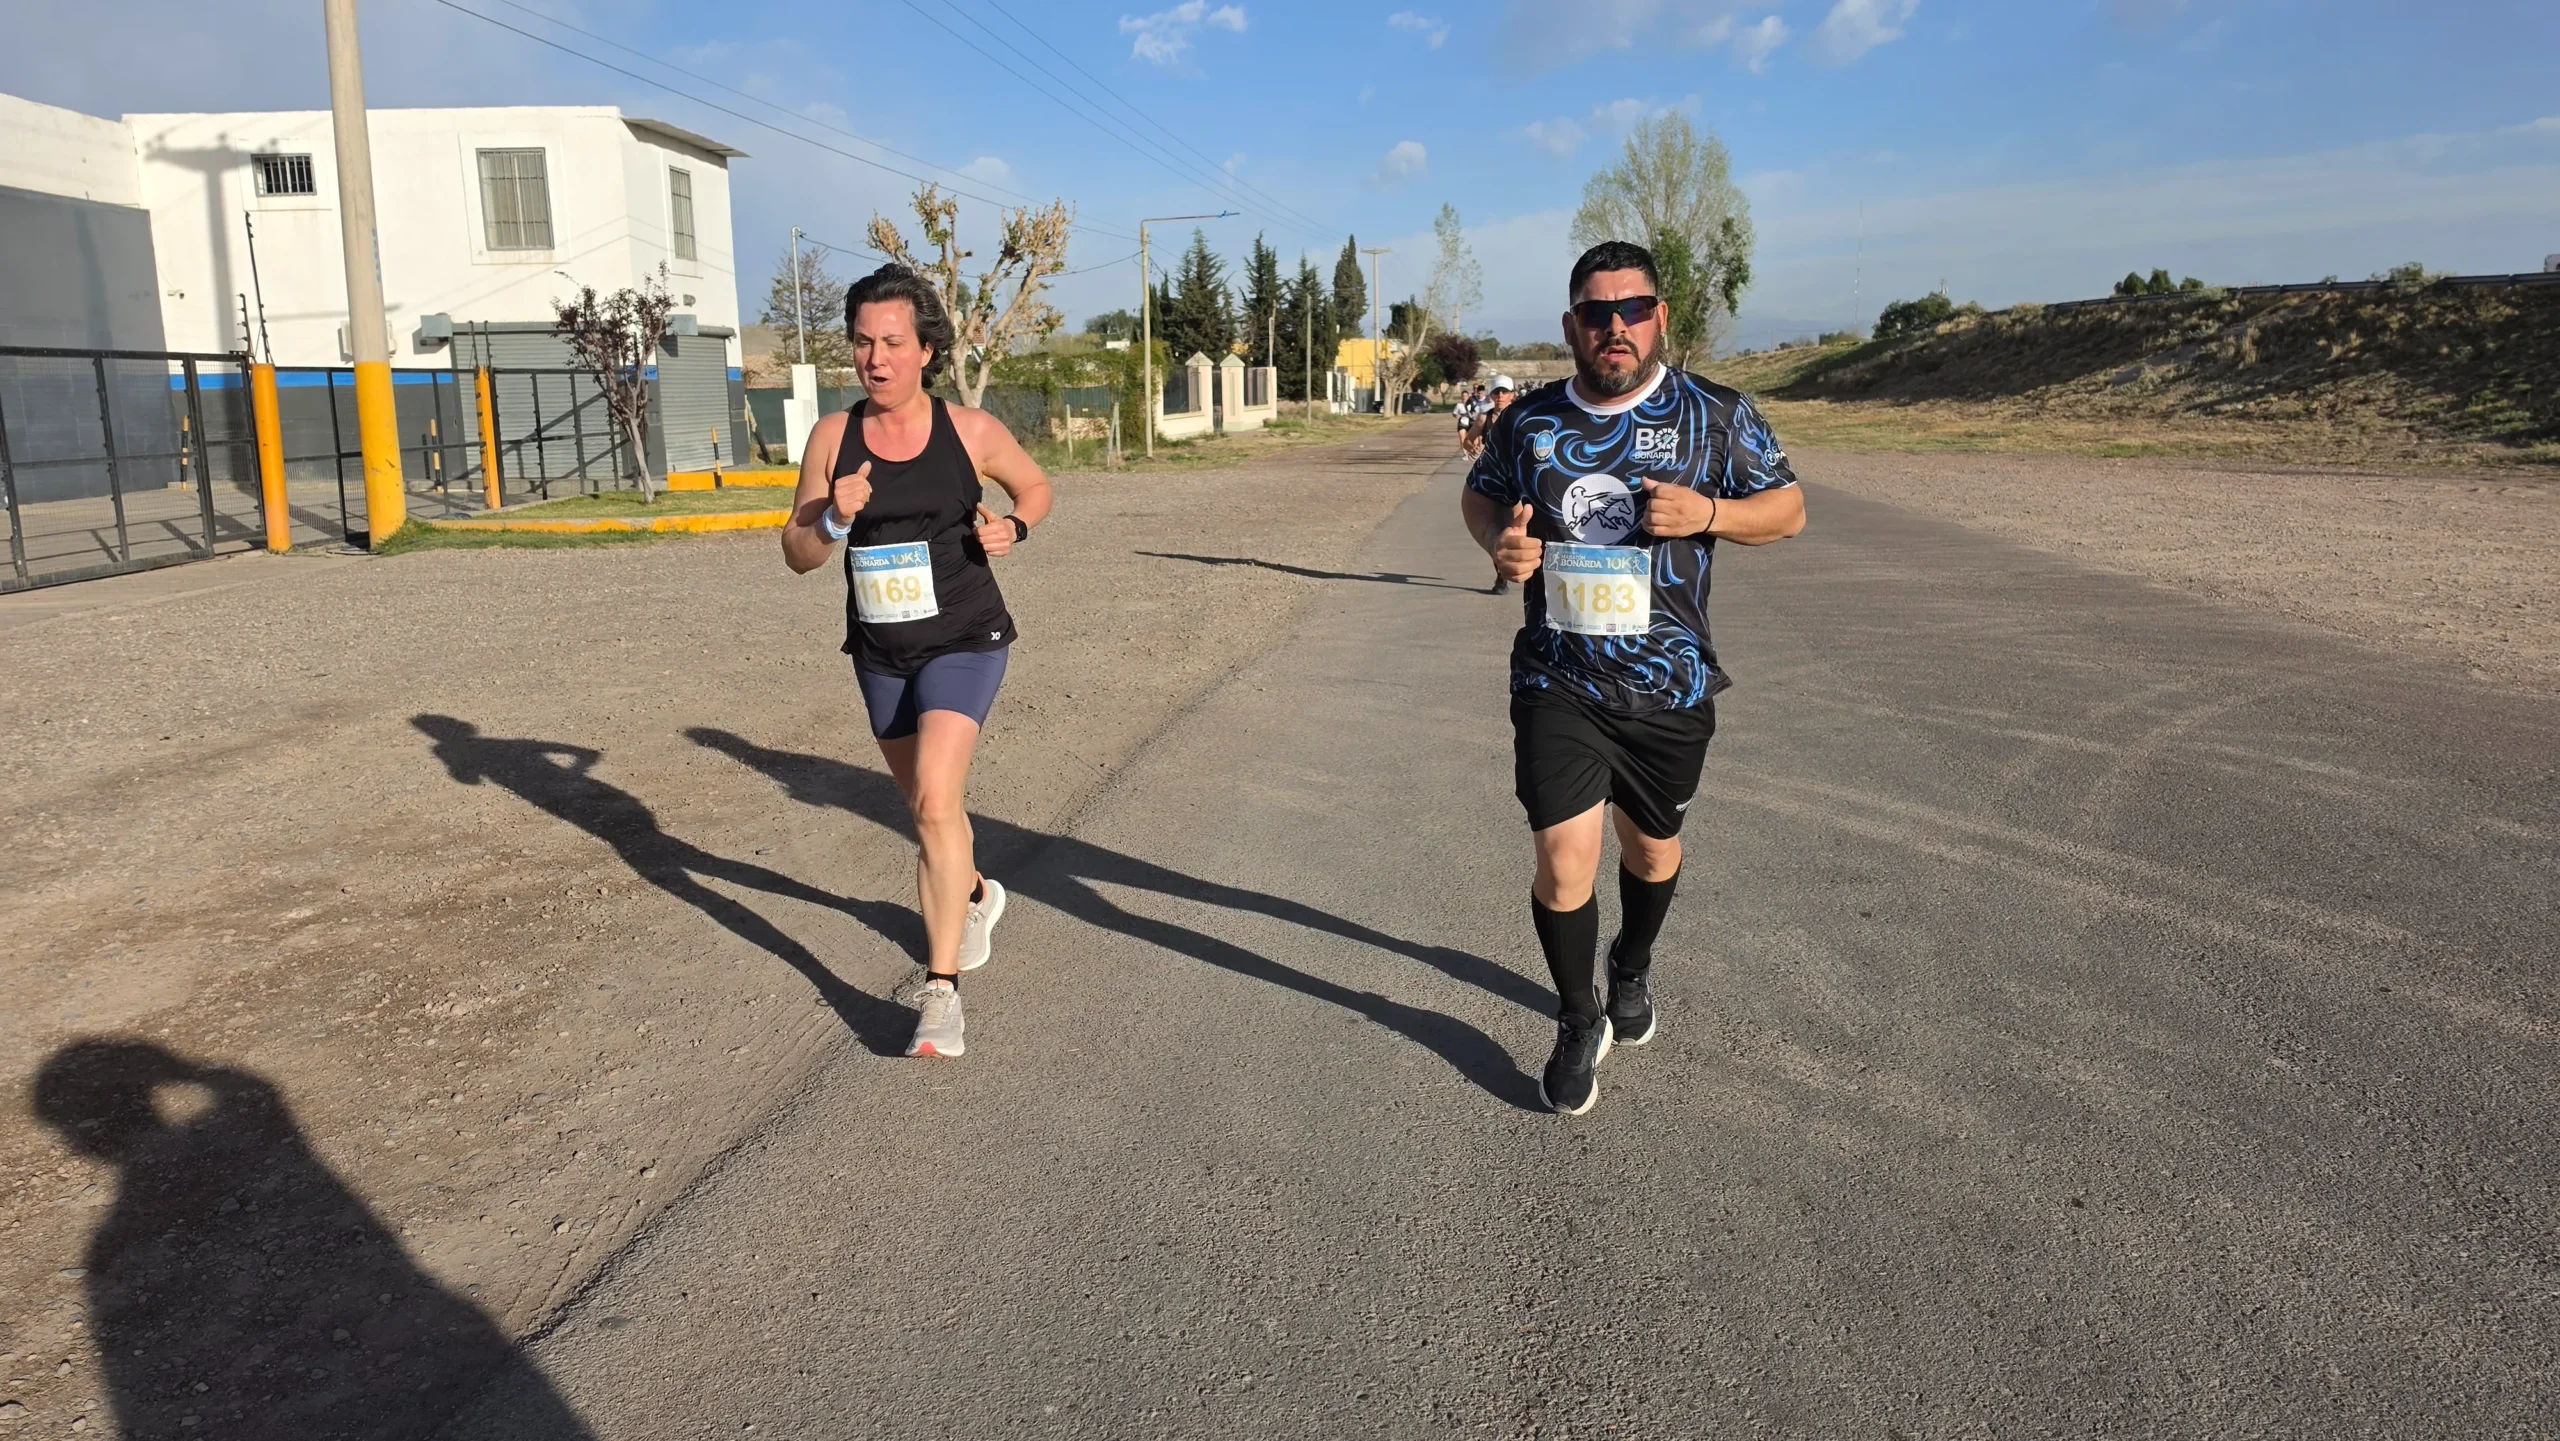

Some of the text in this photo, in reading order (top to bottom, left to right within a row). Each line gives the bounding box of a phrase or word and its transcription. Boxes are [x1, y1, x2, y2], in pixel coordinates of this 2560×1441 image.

[855, 553, 915, 568] BONARDA 10K
[1561, 557, 1632, 570] BONARDA 10K
[859, 575, 921, 605] 1169
[1557, 581, 1636, 614] 1183
